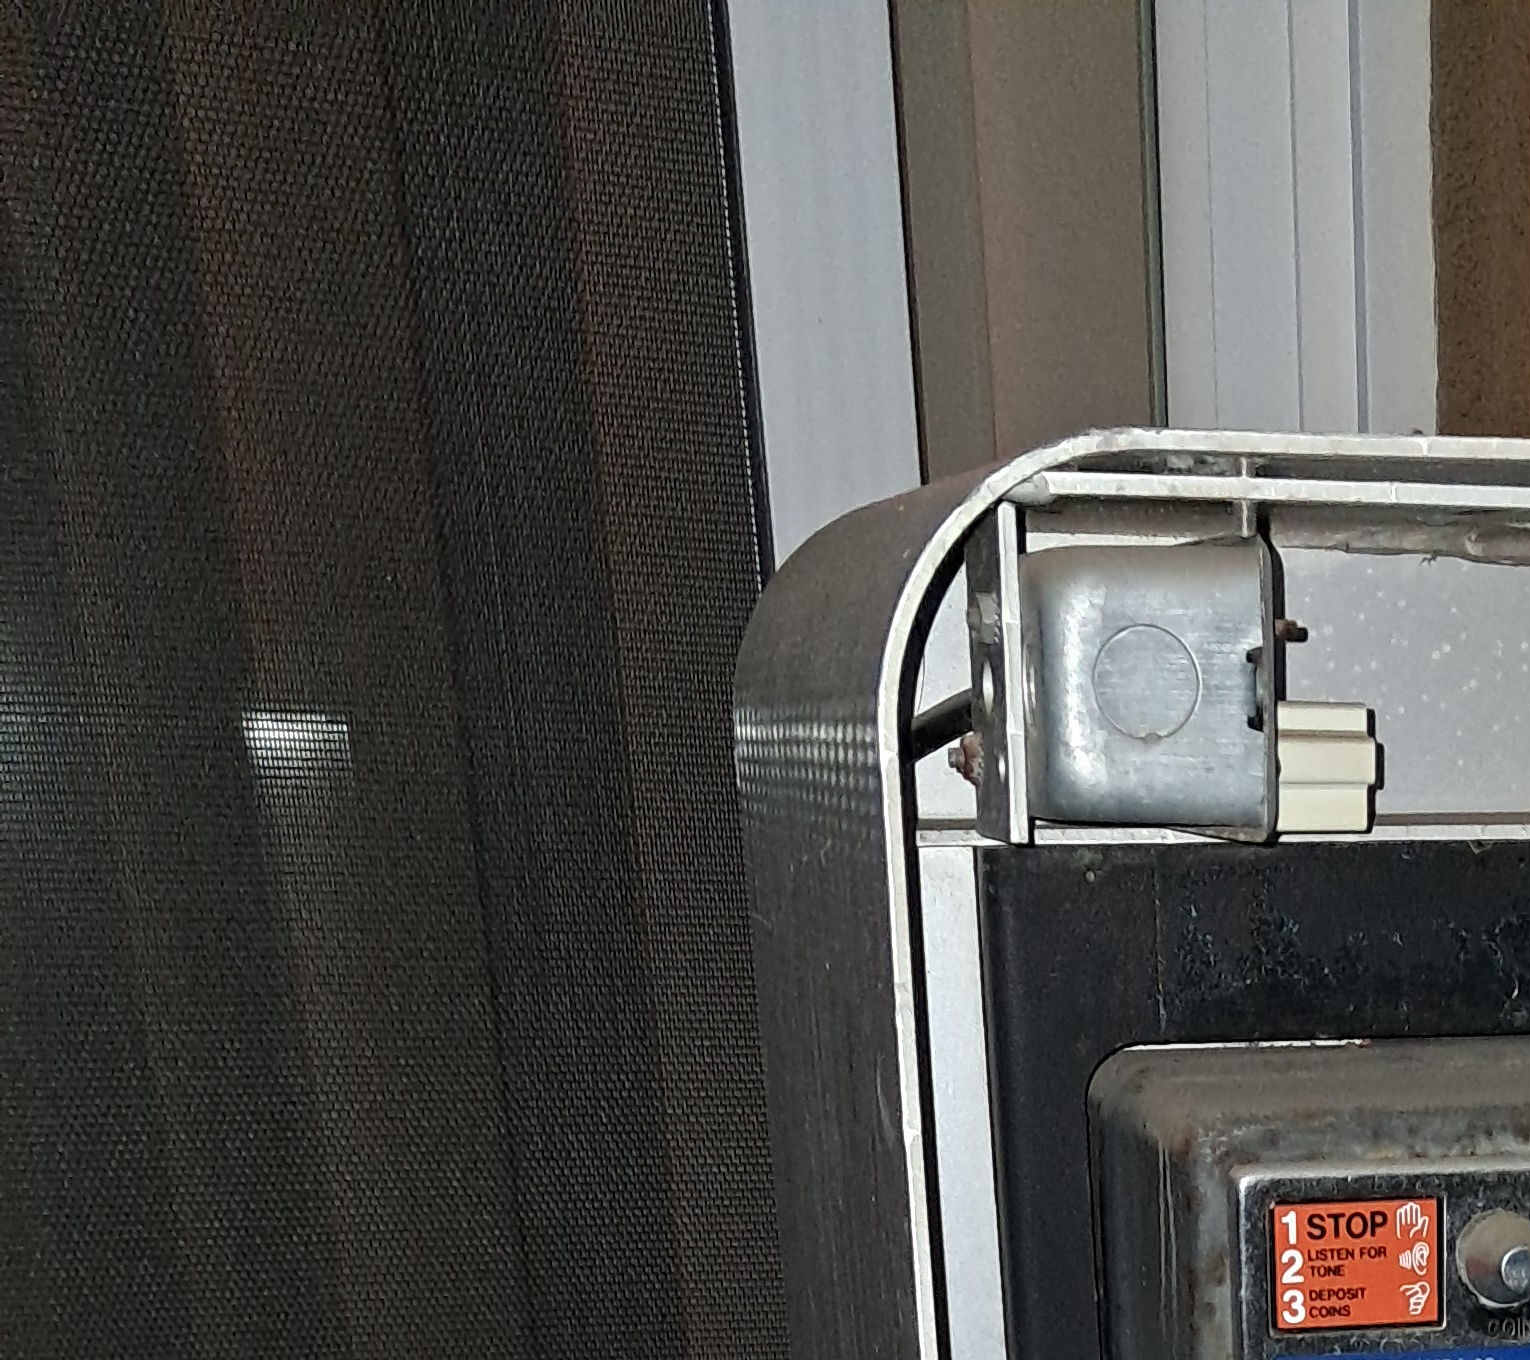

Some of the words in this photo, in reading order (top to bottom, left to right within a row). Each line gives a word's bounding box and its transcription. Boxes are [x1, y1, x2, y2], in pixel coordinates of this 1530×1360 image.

[1281, 1210, 1298, 1245] 1
[1306, 1210, 1388, 1241] STOP
[1281, 1248, 1305, 1284] 2
[1307, 1247, 1355, 1262] LISTEN
[1359, 1246, 1387, 1260] FOR
[1309, 1264, 1346, 1278] TONE
[1282, 1288, 1306, 1324] 3
[1308, 1287, 1367, 1302] DEPOSIT
[1308, 1305, 1351, 1319] COINS
